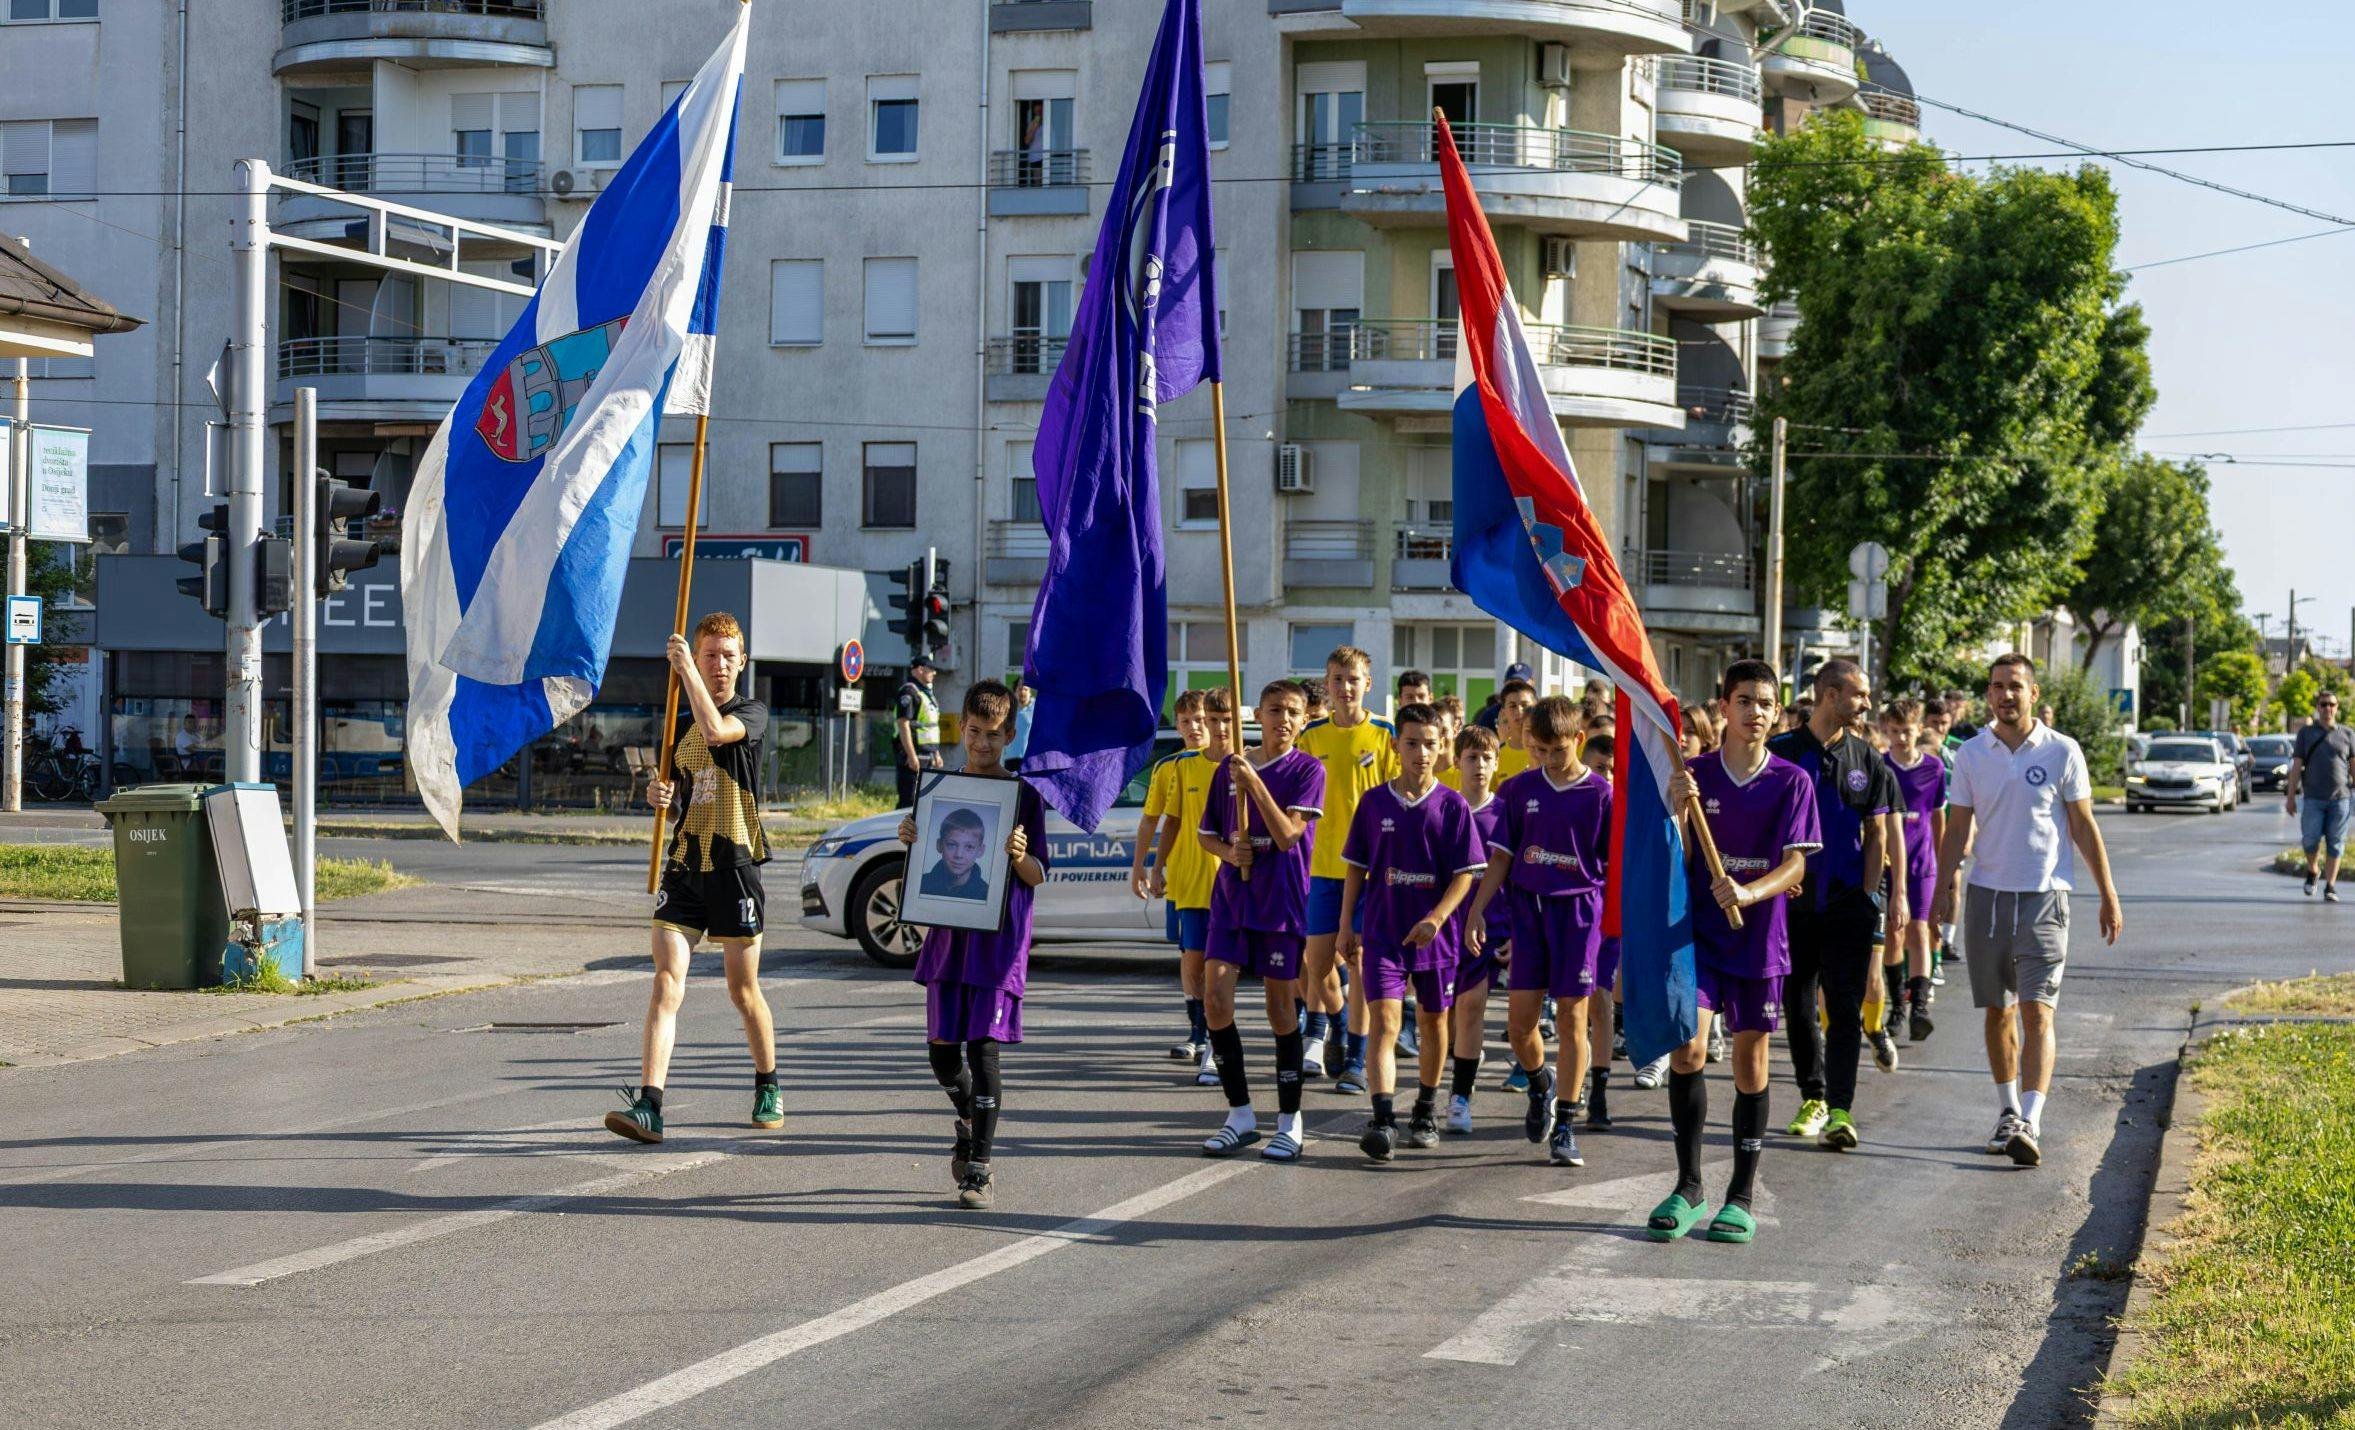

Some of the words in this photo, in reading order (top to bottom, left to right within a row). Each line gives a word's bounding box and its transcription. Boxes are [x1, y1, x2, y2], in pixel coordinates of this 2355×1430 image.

[130, 828, 167, 844] OSIJEK
[1046, 841, 1127, 858] LICIJA
[1530, 848, 1578, 866] nippon
[1721, 853, 1770, 872] ippon
[1061, 871, 1129, 883] POVJERENJE
[1390, 867, 1435, 886] nippon
[738, 897, 757, 923] 12
